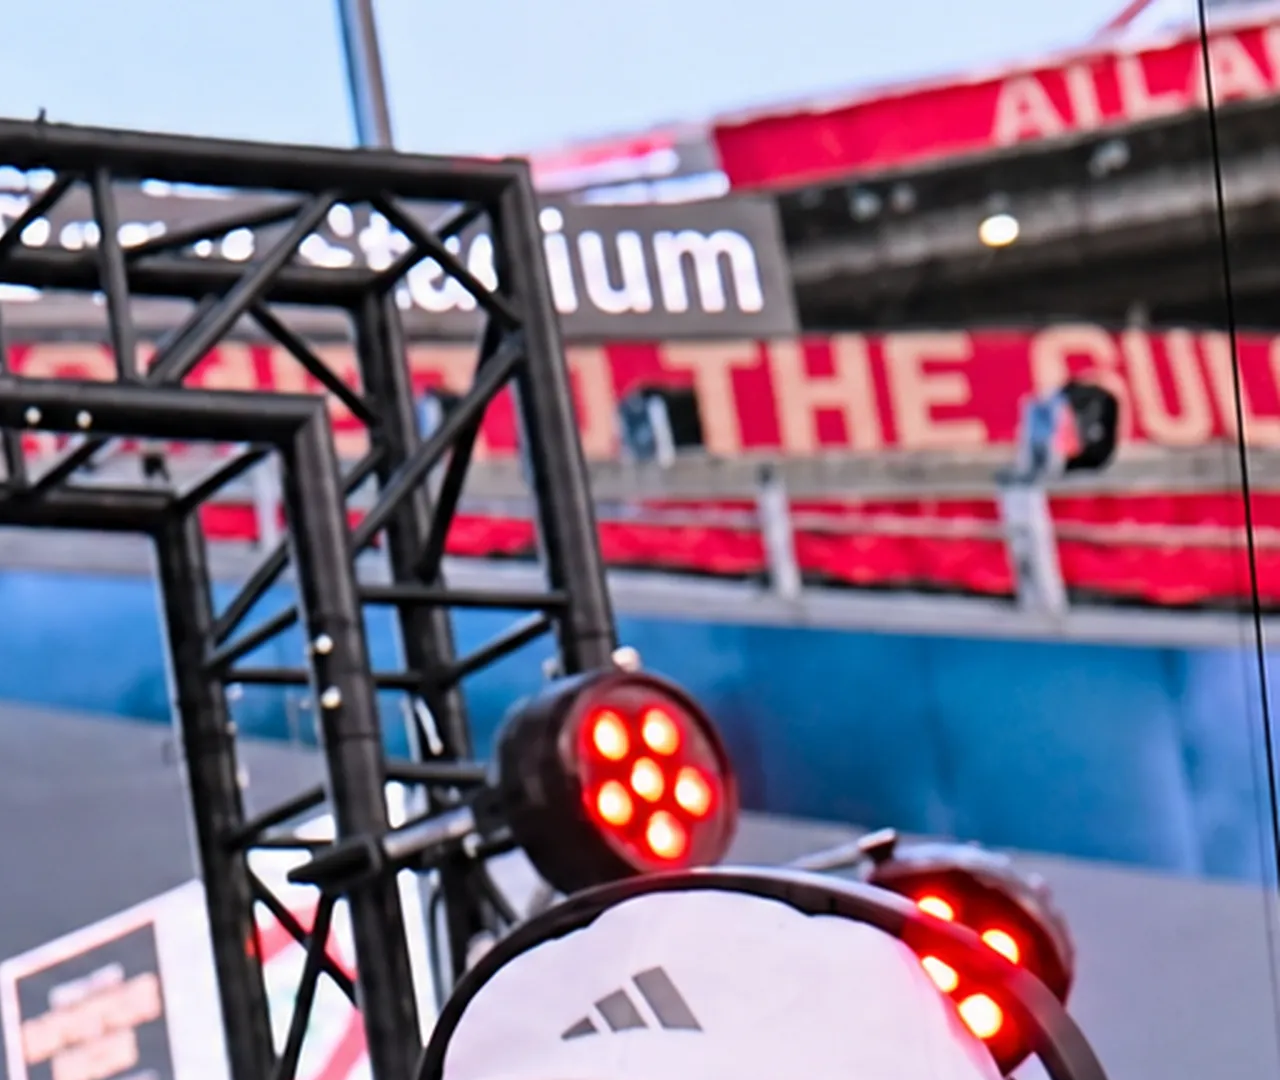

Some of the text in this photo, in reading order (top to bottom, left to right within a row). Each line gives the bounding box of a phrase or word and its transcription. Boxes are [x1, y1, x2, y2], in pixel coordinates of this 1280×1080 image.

[992, 28, 1280, 147] ATLA
[662, 331, 988, 454] THE
[1028, 322, 1280, 450] GUL
